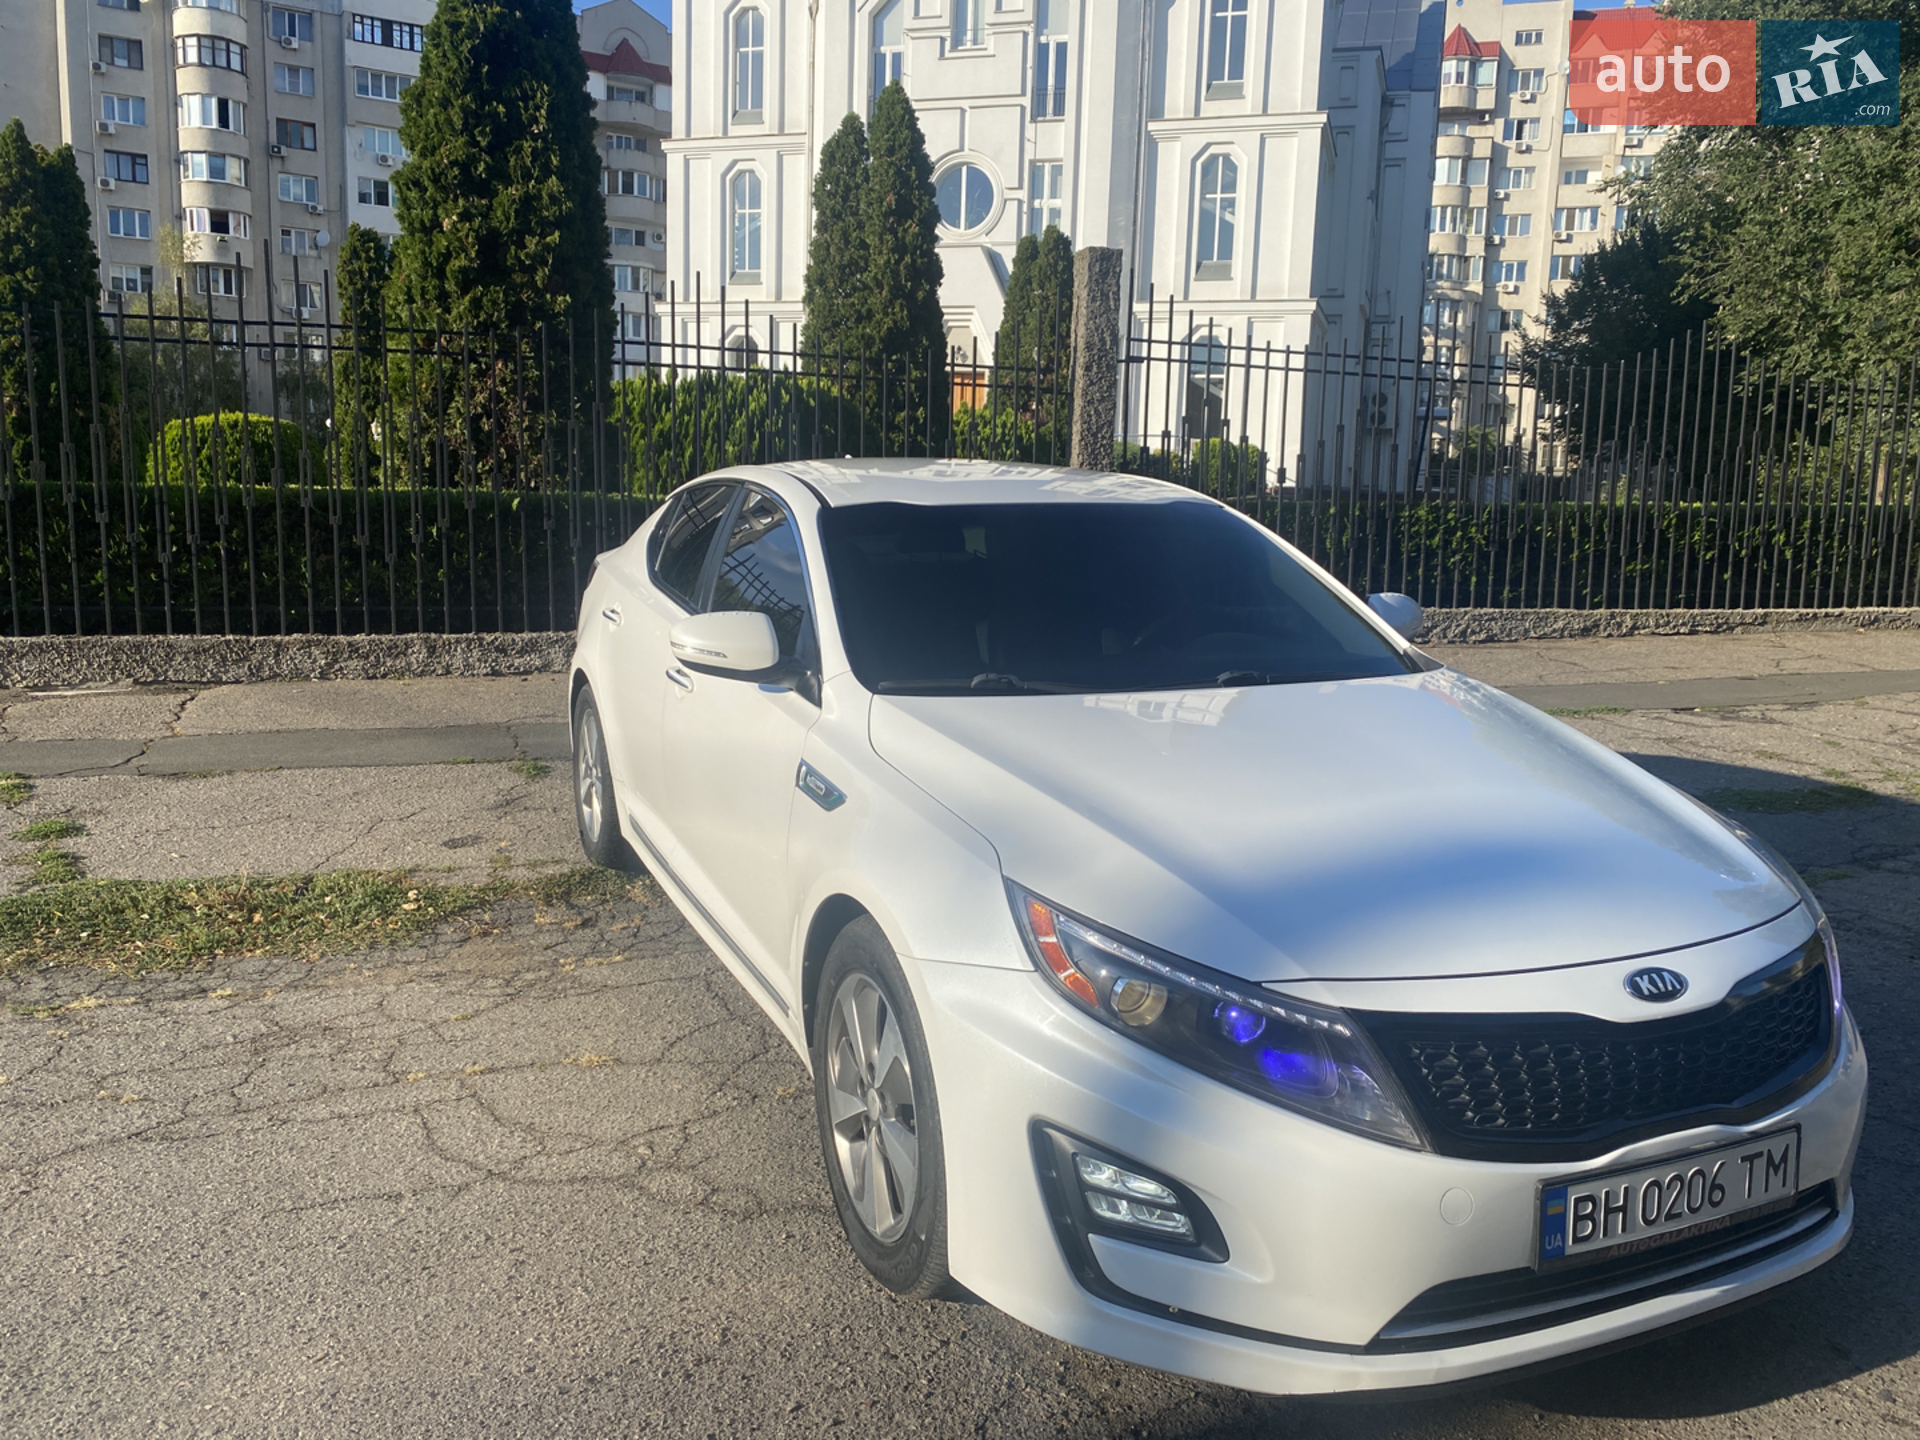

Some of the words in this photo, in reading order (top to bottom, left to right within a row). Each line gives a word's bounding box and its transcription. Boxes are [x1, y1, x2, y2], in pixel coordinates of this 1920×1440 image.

[1633, 971, 1681, 996] KIA
[1569, 1183, 1630, 1246] BH
[1639, 1159, 1727, 1227] 0206
[1738, 1143, 1789, 1199] TM
[1544, 1232, 1563, 1250] UA
